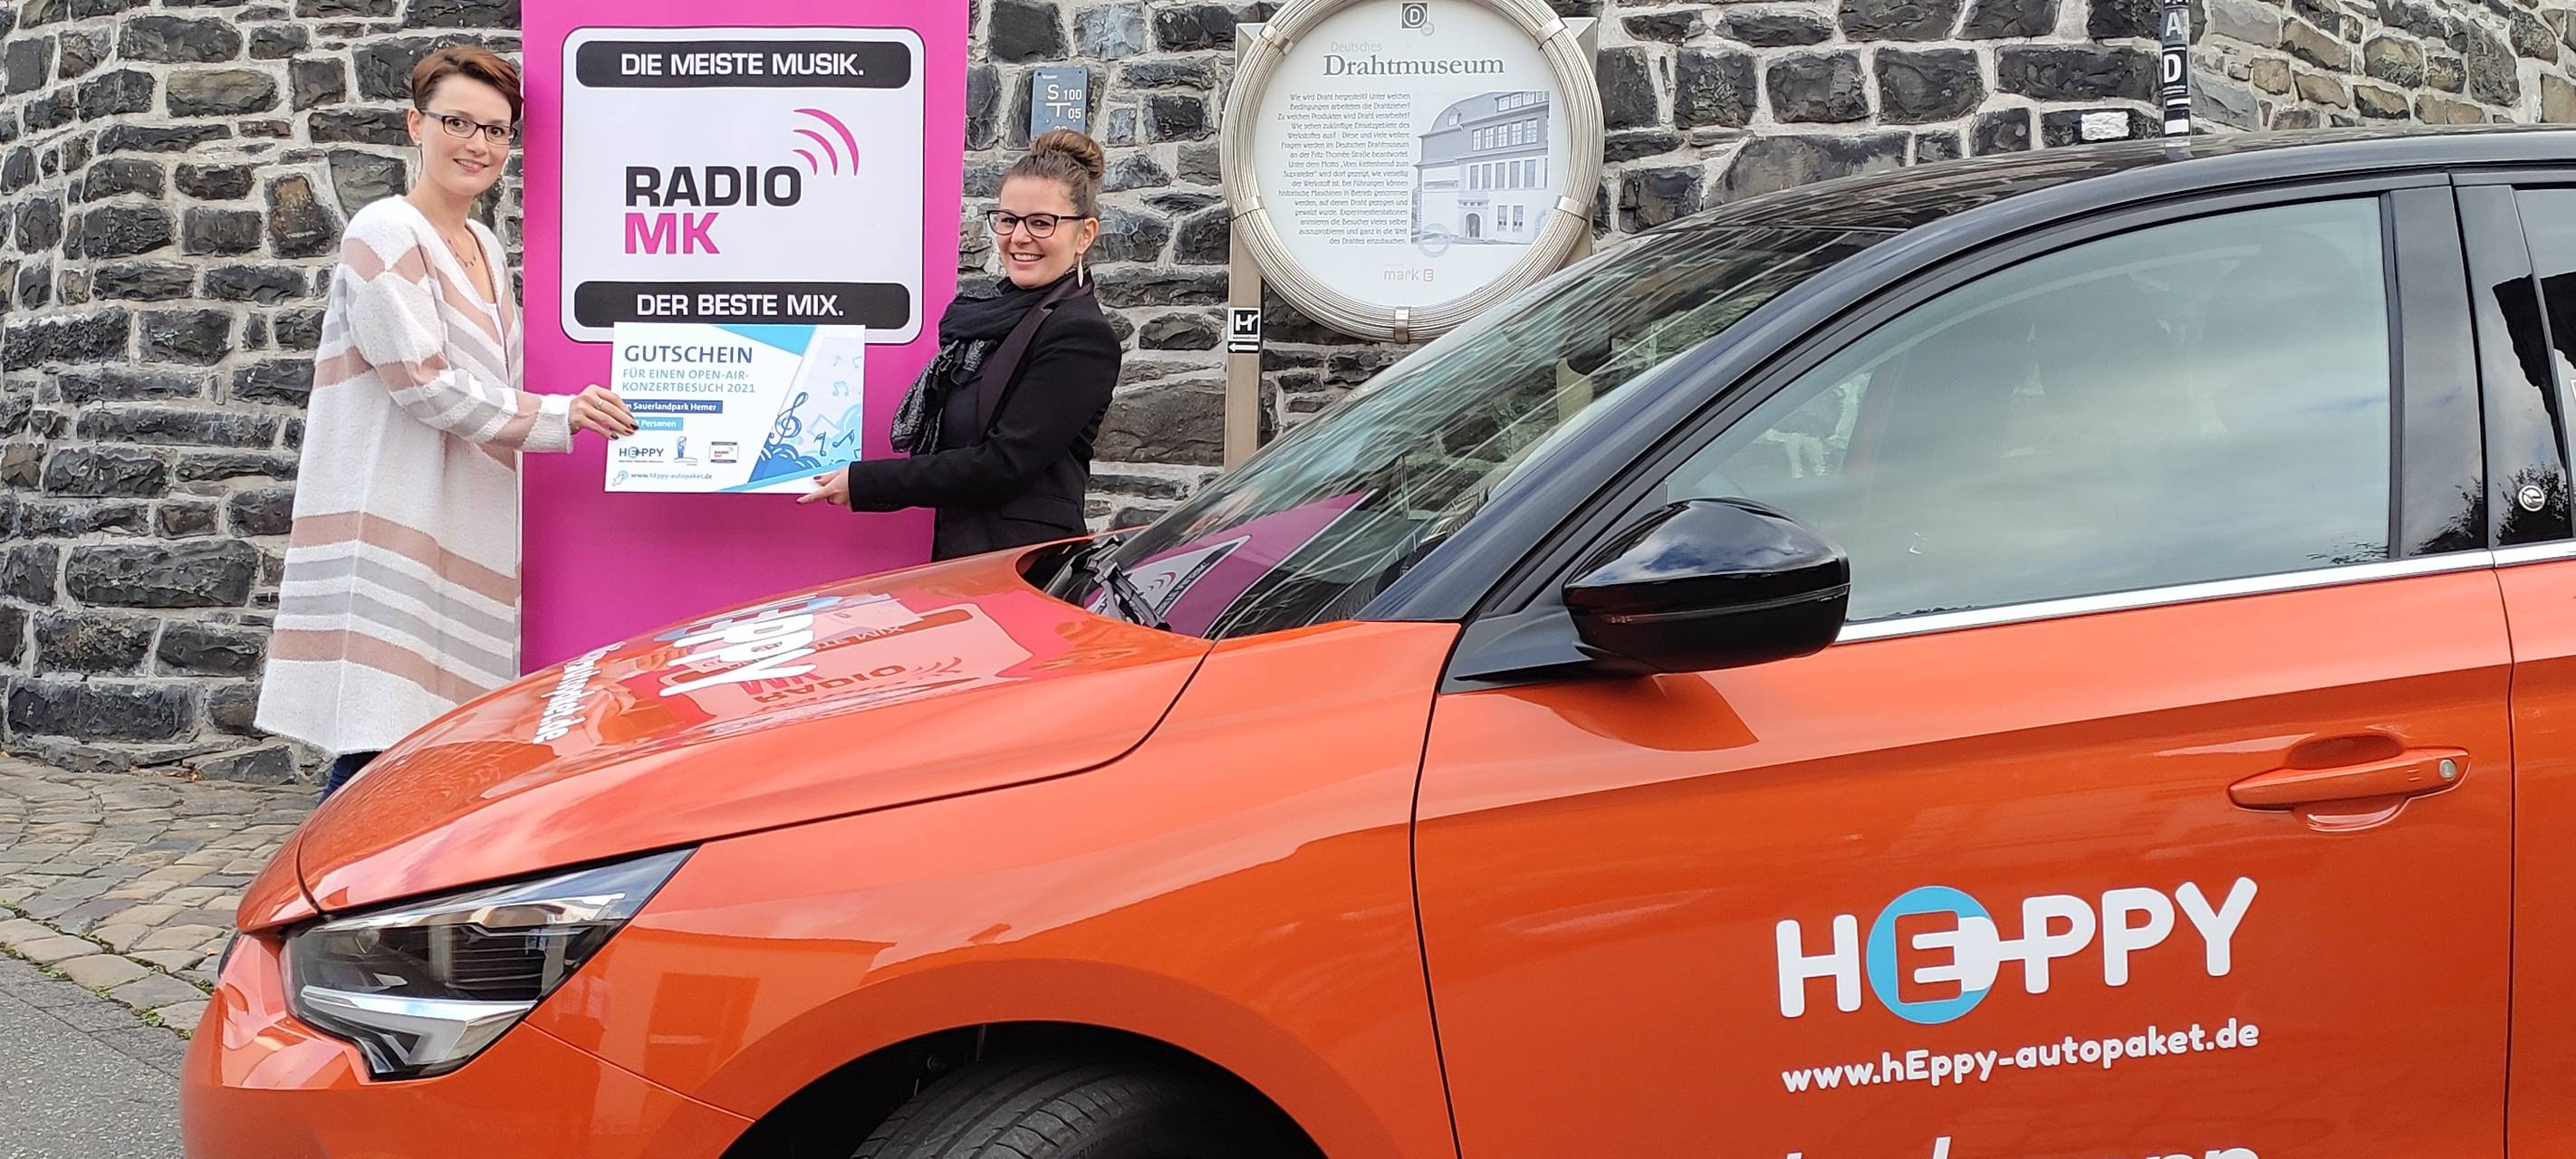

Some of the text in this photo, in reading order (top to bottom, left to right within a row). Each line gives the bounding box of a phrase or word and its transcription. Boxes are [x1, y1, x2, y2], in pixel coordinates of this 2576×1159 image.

[1331, 42, 1382, 53] Deutsches
[621, 53, 864, 75] DIE MEISTE MUSIK.
[1322, 54, 1505, 76] Drahtmuseum
[1047, 84, 1082, 101] S 100
[1068, 108, 1081, 120] 05
[626, 166, 802, 206] RADIO
[625, 212, 721, 254] MK
[1384, 268, 1419, 281] mark
[637, 294, 844, 316] DER BESTE MIX.
[624, 345, 753, 363] GUTSCHEIN
[623, 367, 749, 380] FÜR EINEN OPEN-AIR-
[622, 382, 755, 393] KONZERTBESUCH 2021
[633, 402, 688, 413] Sauerlandpark
[691, 403, 717, 411] Hemer
[641, 419, 678, 427] Personen
[1782, 1017, 2260, 1093] www.hEppy-autopaket.de
